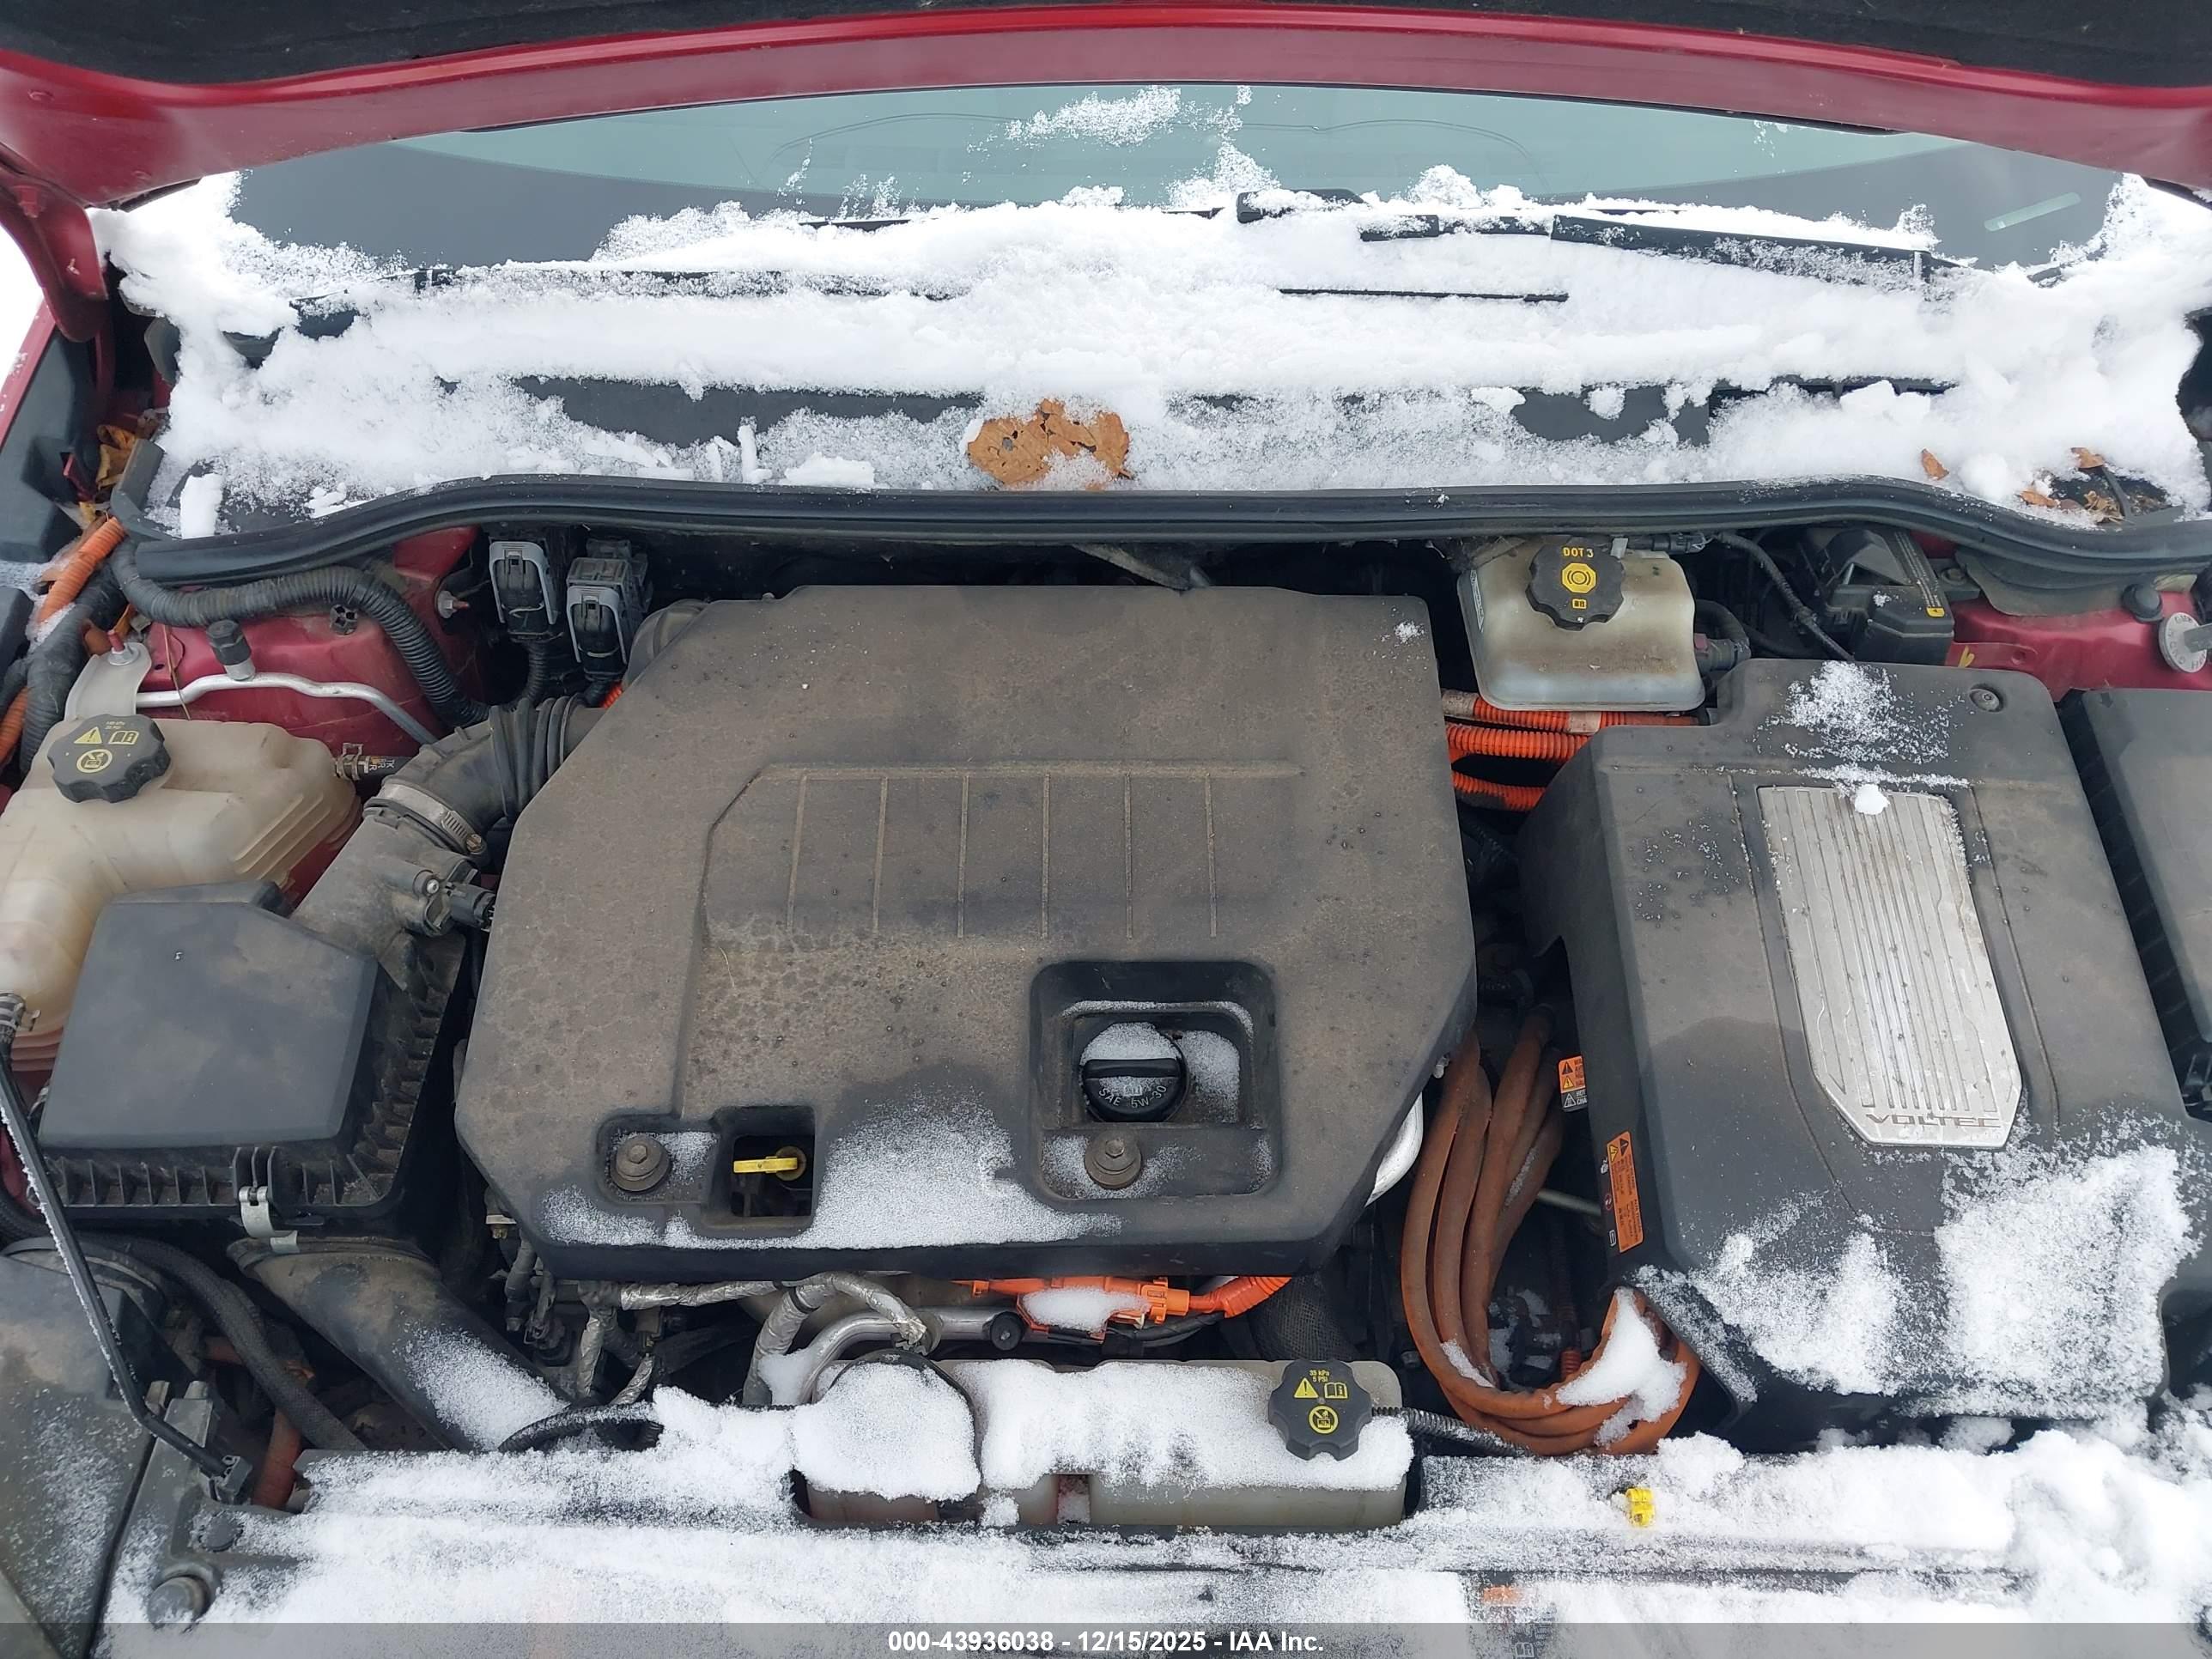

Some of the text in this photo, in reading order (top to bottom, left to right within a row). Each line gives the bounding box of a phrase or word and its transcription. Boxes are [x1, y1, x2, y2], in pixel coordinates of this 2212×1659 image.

[1563, 547, 1594, 558] DOT 3
[1098, 1085, 1167, 1109] SAE 5W-30
[1865, 1114, 2001, 1128] VOLTEC
